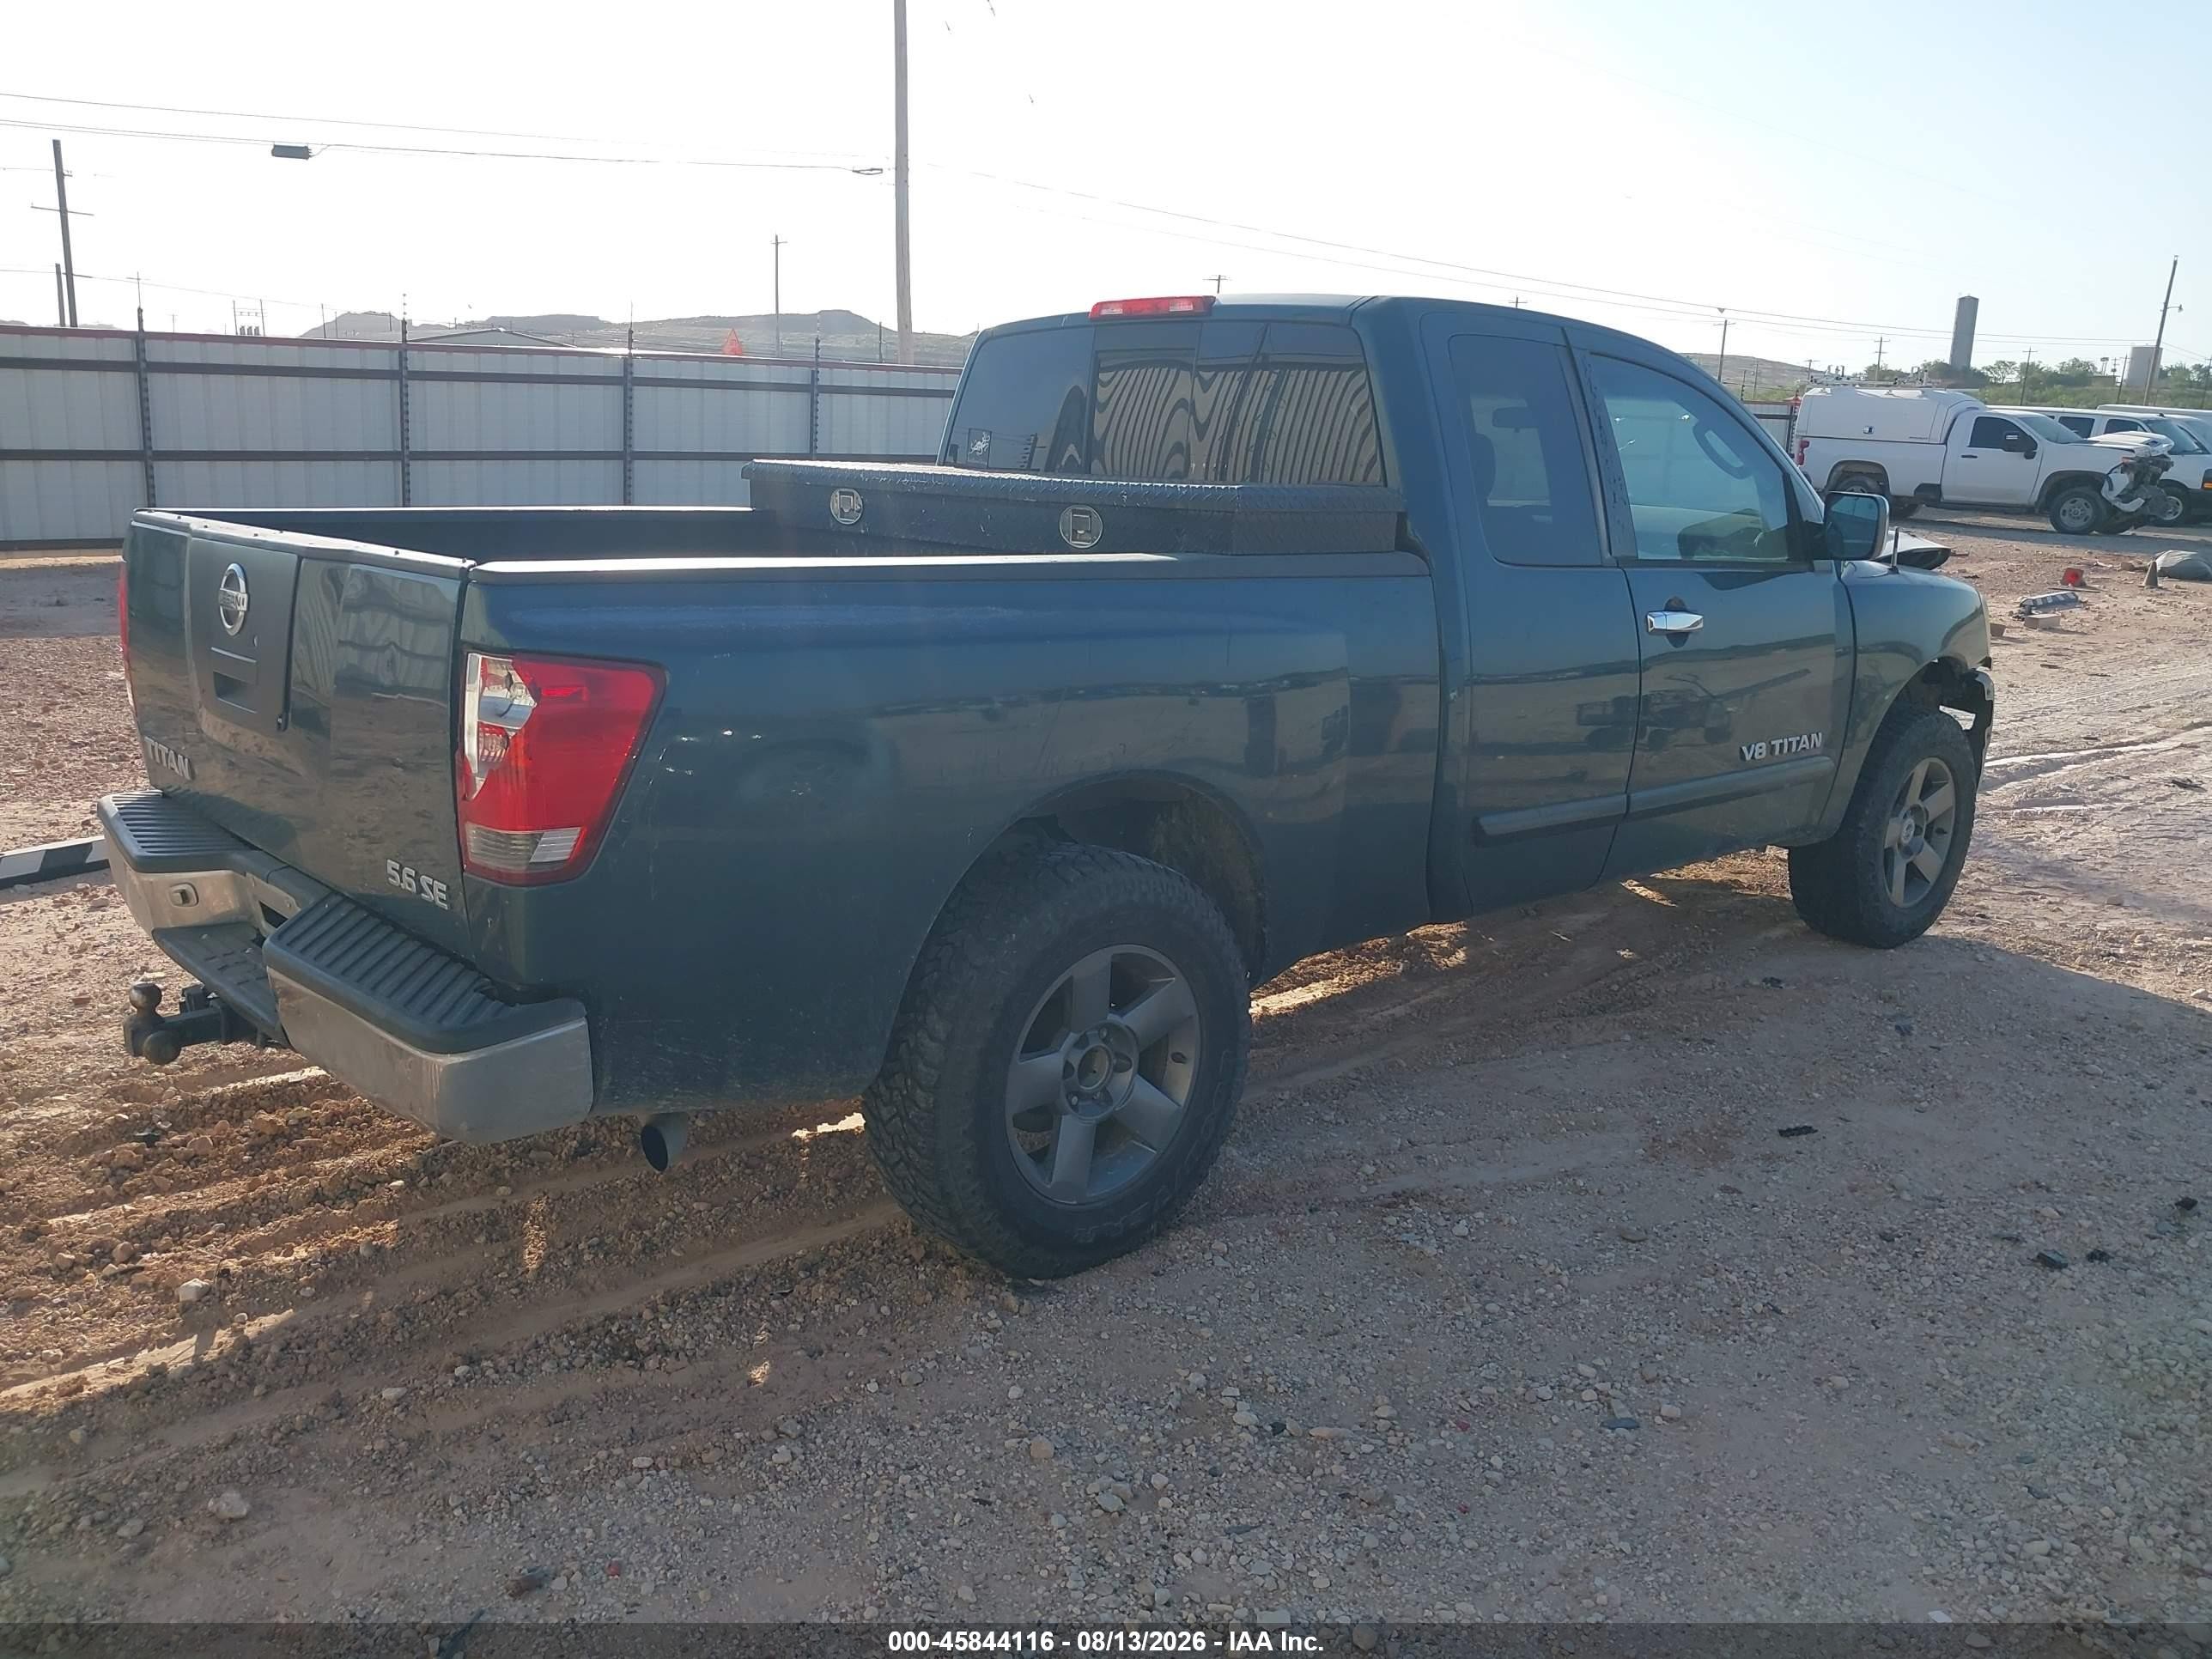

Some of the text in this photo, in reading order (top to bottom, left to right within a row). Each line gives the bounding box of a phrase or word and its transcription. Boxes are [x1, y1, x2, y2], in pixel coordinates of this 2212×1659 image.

[144, 736, 191, 781] TITAN
[1741, 732, 1822, 761] V8 TITAN
[420, 874, 448, 910] SE
